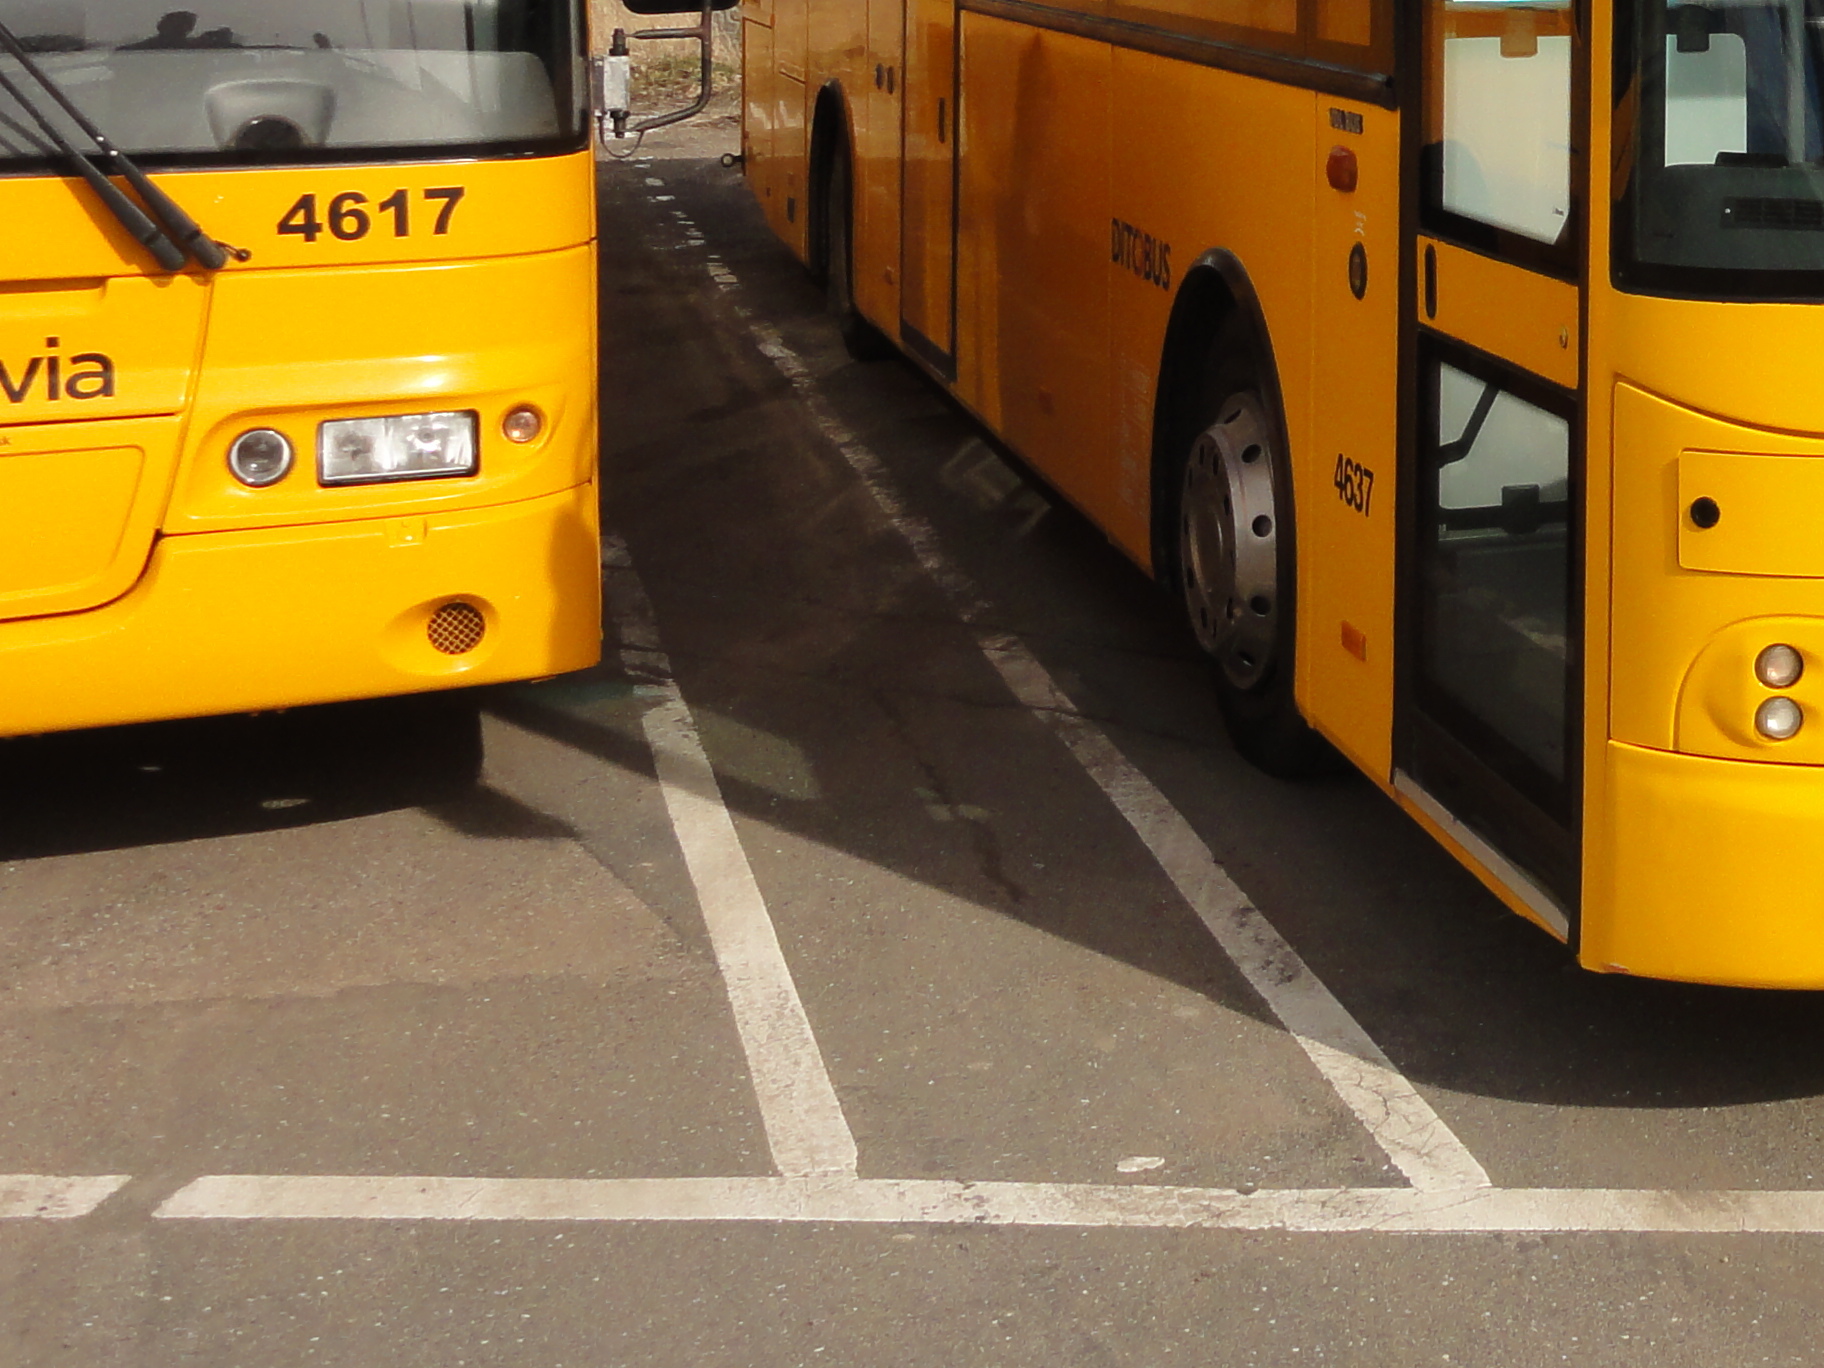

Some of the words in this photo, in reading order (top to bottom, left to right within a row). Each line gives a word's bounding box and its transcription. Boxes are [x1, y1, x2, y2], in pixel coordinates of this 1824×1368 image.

[276, 186, 465, 243] 4617
[1111, 217, 1171, 292] DITOBUS
[1334, 452, 1374, 518] 4637
